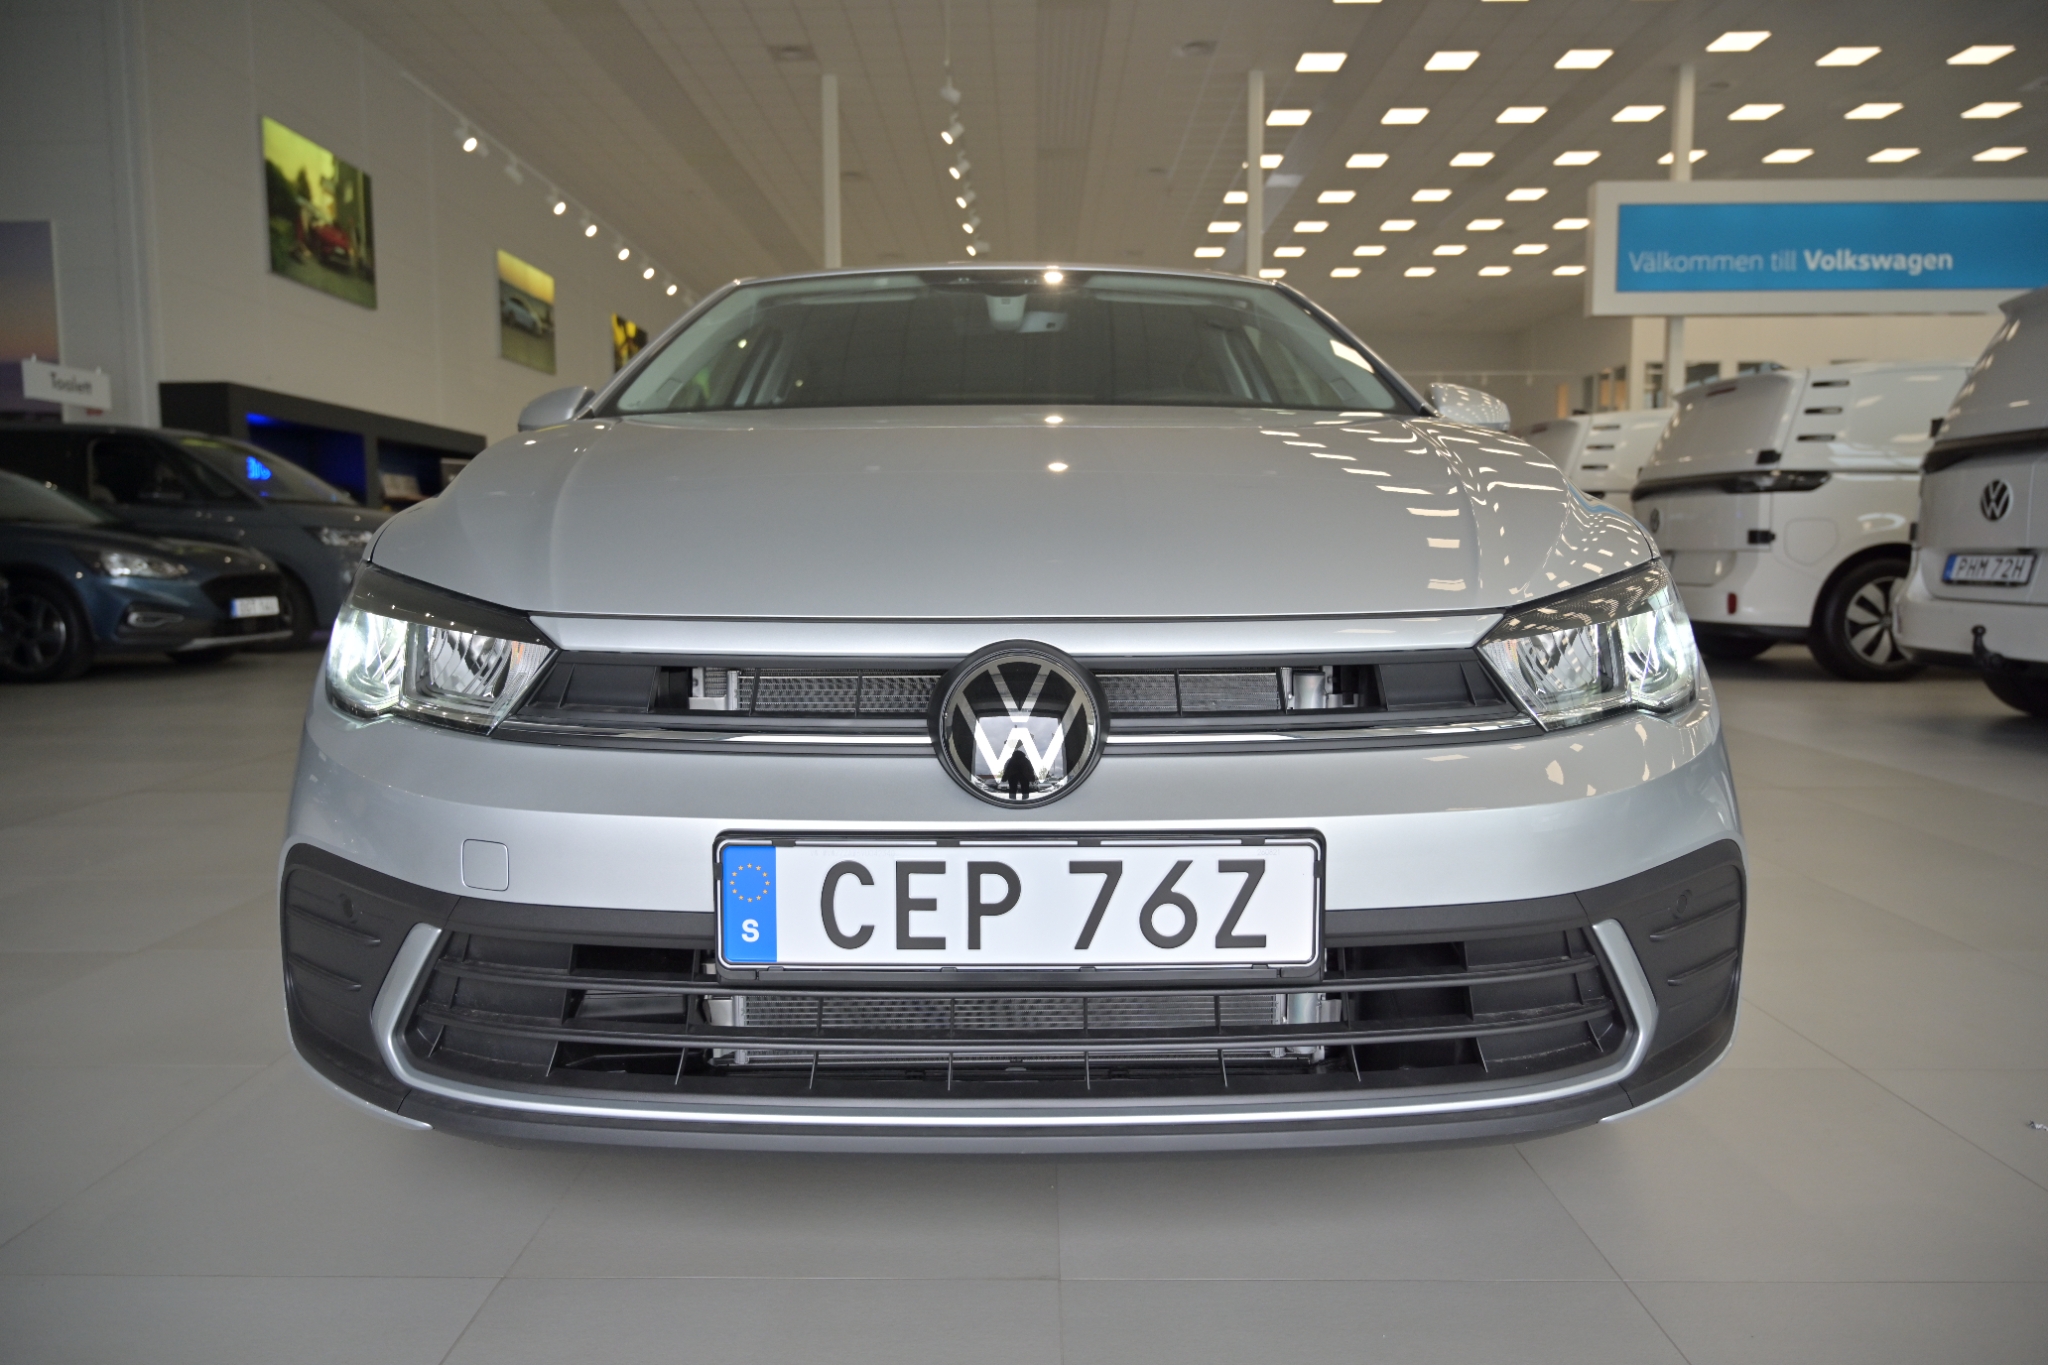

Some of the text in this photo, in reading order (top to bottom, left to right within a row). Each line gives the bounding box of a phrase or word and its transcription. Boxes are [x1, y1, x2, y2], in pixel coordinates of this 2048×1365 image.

[1628, 249, 1954, 276] Välkommen till Volkswagen
[1991, 557, 2026, 579] 72H
[820, 859, 1267, 951] CEP 76Z
[741, 918, 760, 943] S
